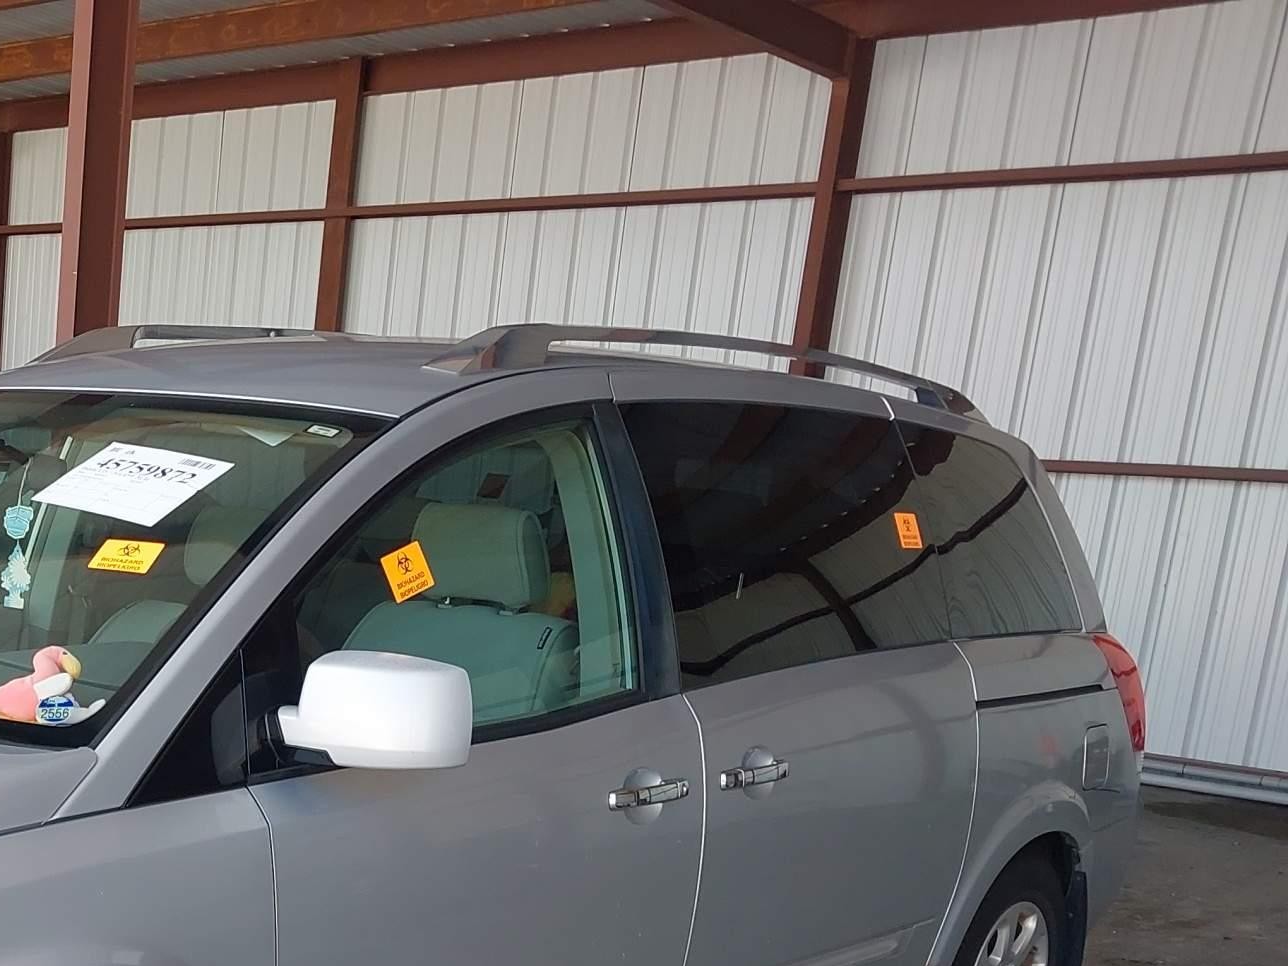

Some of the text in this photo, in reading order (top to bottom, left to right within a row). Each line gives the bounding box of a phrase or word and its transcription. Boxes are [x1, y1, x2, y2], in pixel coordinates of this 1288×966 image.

[97, 458, 197, 484] 45759872
[396, 571, 426, 590] BIOHAZARD
[40, 708, 70, 719] 2556
